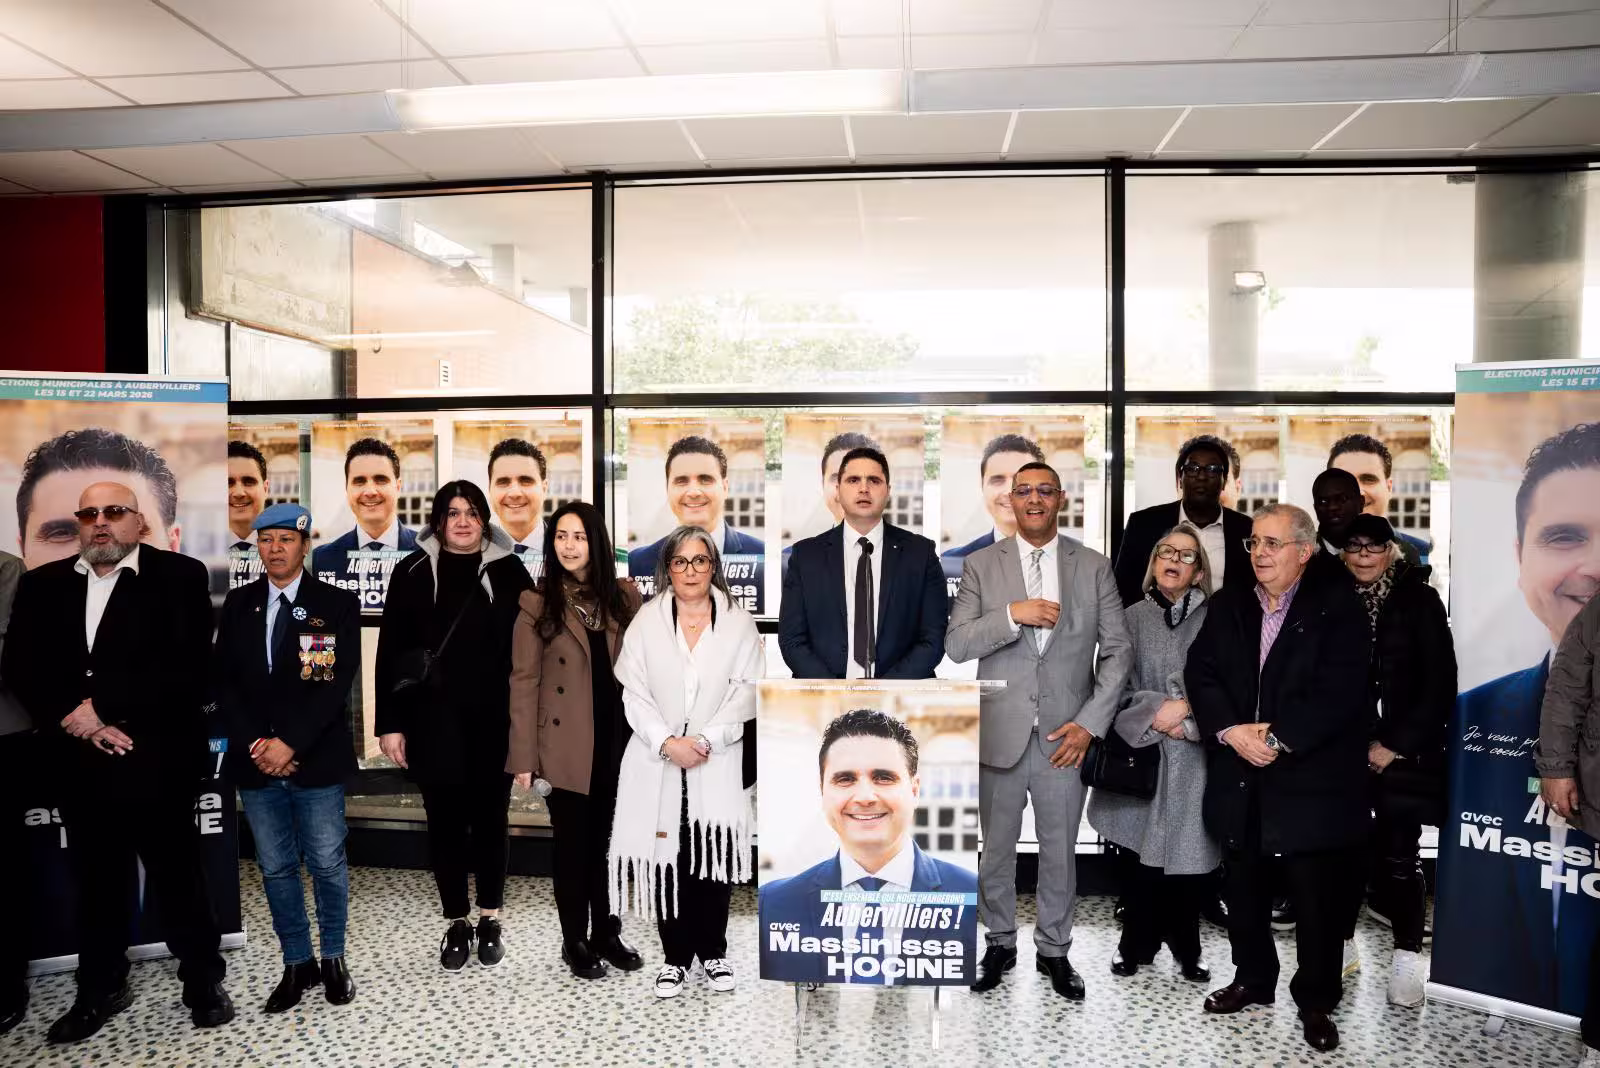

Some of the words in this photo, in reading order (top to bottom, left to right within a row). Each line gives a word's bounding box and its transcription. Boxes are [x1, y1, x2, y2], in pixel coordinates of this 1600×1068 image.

[42, 380, 113, 389] MUNICIPALES
[124, 382, 201, 391] AUBERVILLIERS
[1541, 378, 1563, 387] LES
[1567, 378, 1578, 386] 15
[1581, 377, 1598, 386] ET
[34, 389, 54, 397] LES
[98, 391, 127, 399] MARS
[1462, 725, 1484, 742] Je
[1487, 732, 1518, 744] veux
[1463, 743, 1486, 753] au
[1460, 811, 1503, 826] avec
[843, 891, 880, 902] ENSEMBLE
[881, 892, 896, 903] QUE
[896, 893, 917, 903] NOUS
[917, 894, 966, 904] CHANGERONS
[820, 902, 953, 930] Aubervilliers
[953, 904, 965, 930] !
[769, 922, 800, 931] avec
[769, 932, 964, 957] Massinissa
[827, 956, 964, 979] HOCINE
